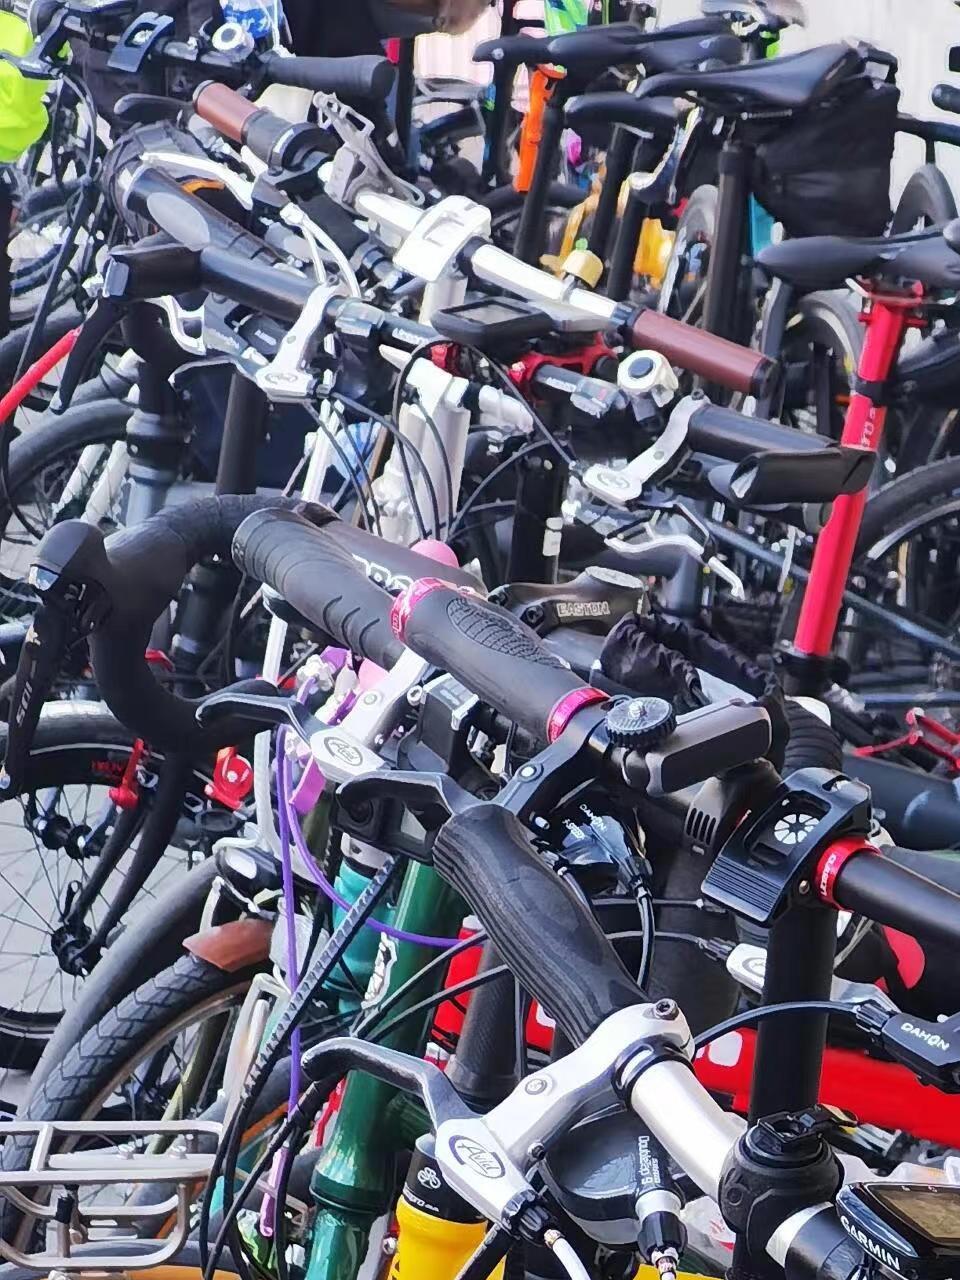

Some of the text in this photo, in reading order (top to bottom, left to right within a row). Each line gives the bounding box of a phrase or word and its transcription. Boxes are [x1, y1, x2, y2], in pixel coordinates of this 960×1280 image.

[556, 601, 610, 617] EASTON
[900, 1022, 950, 1051] DAHON
[840, 1215, 901, 1270] GARMIN
